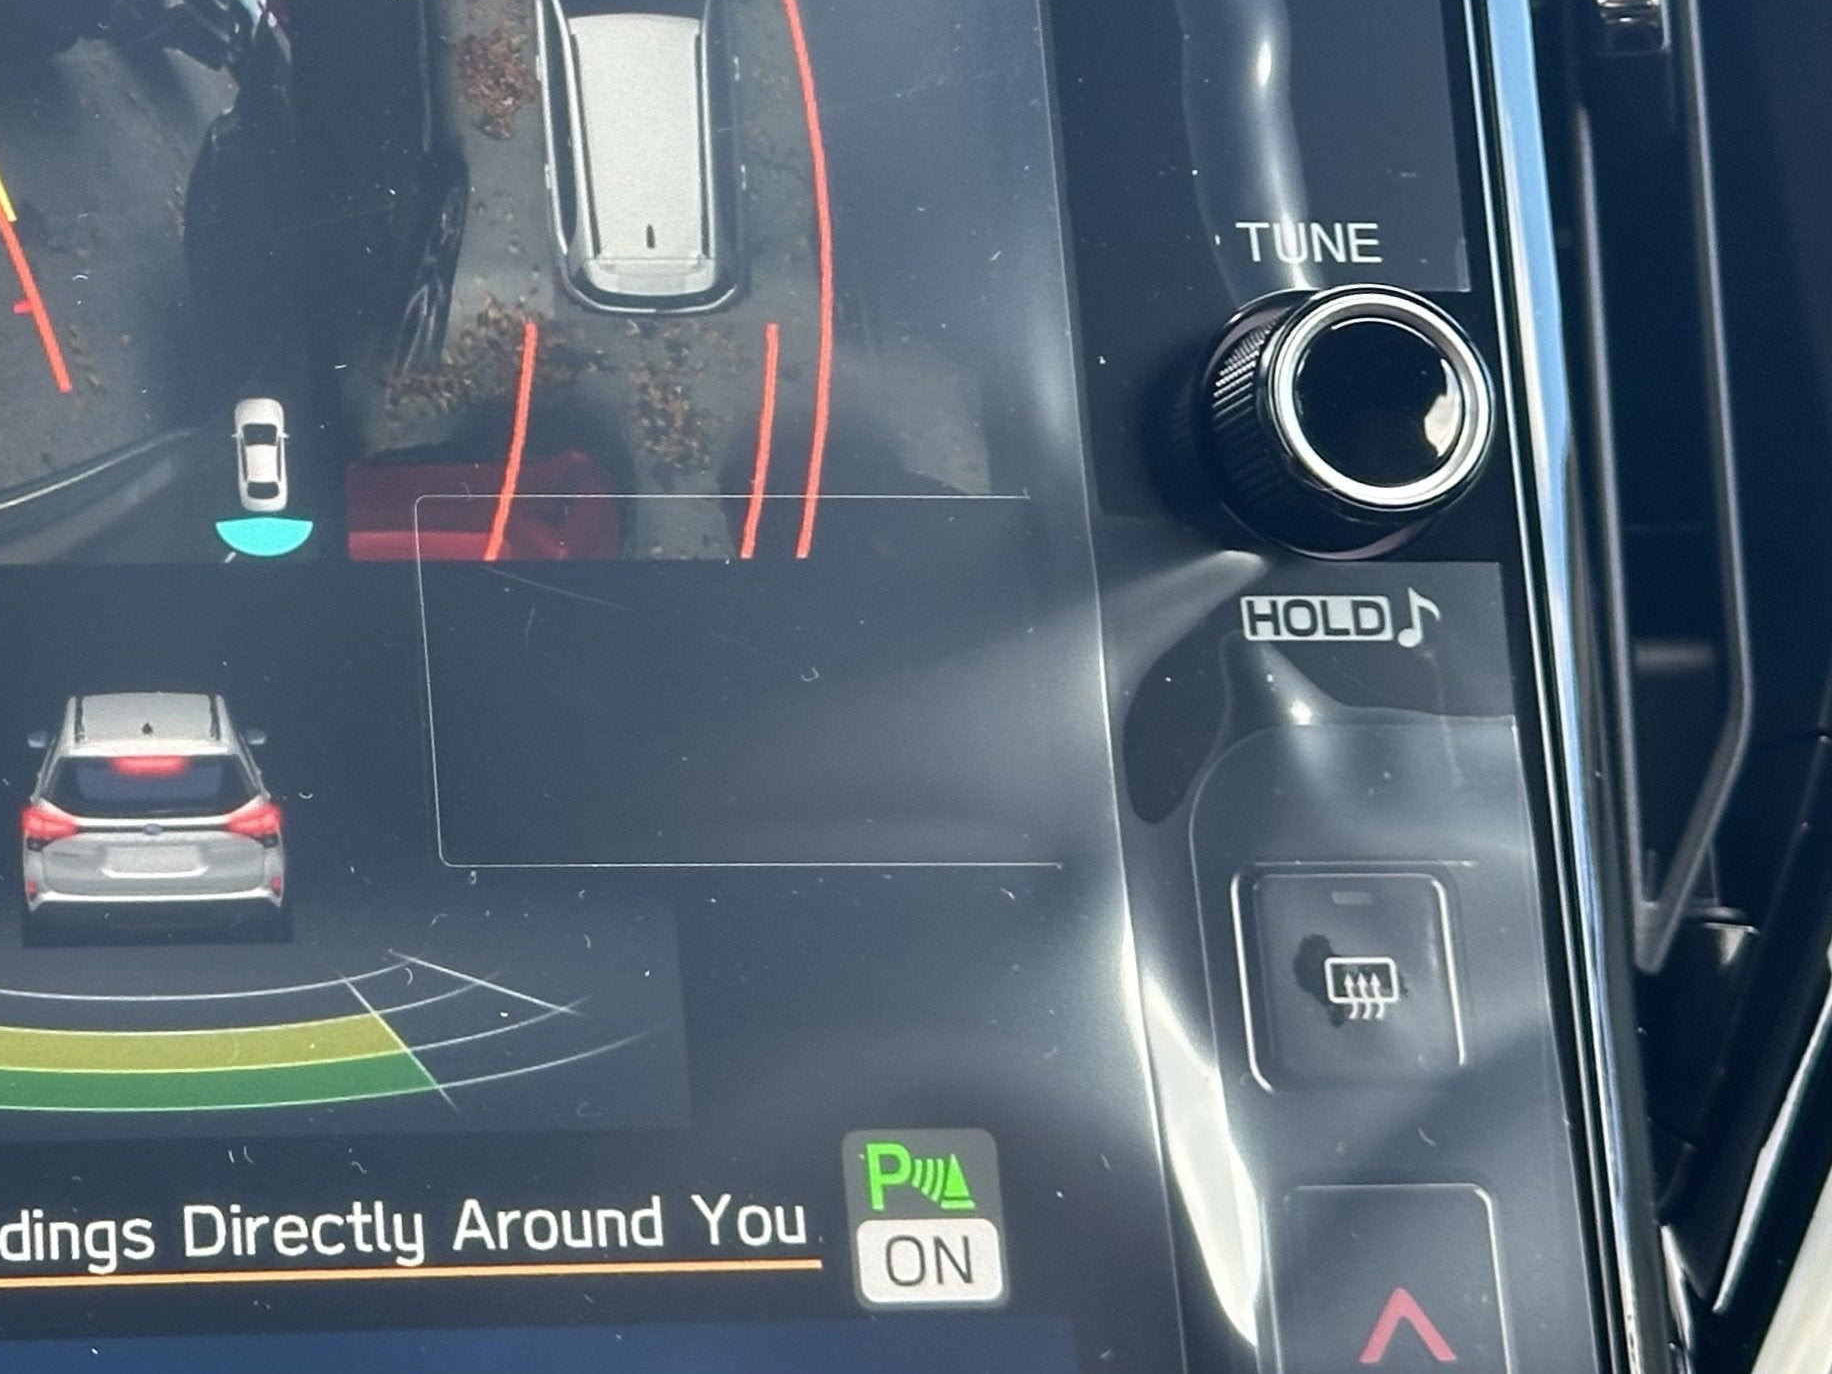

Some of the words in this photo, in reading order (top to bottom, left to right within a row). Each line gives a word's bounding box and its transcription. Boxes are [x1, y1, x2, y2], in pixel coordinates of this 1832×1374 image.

[1235, 221, 1384, 264] TUNE
[1246, 597, 1387, 638] HOLD
[182, 1201, 428, 1268] Directly
[452, 1196, 664, 1252] Around
[690, 1192, 808, 1246] You
[883, 1235, 975, 1288] ON
